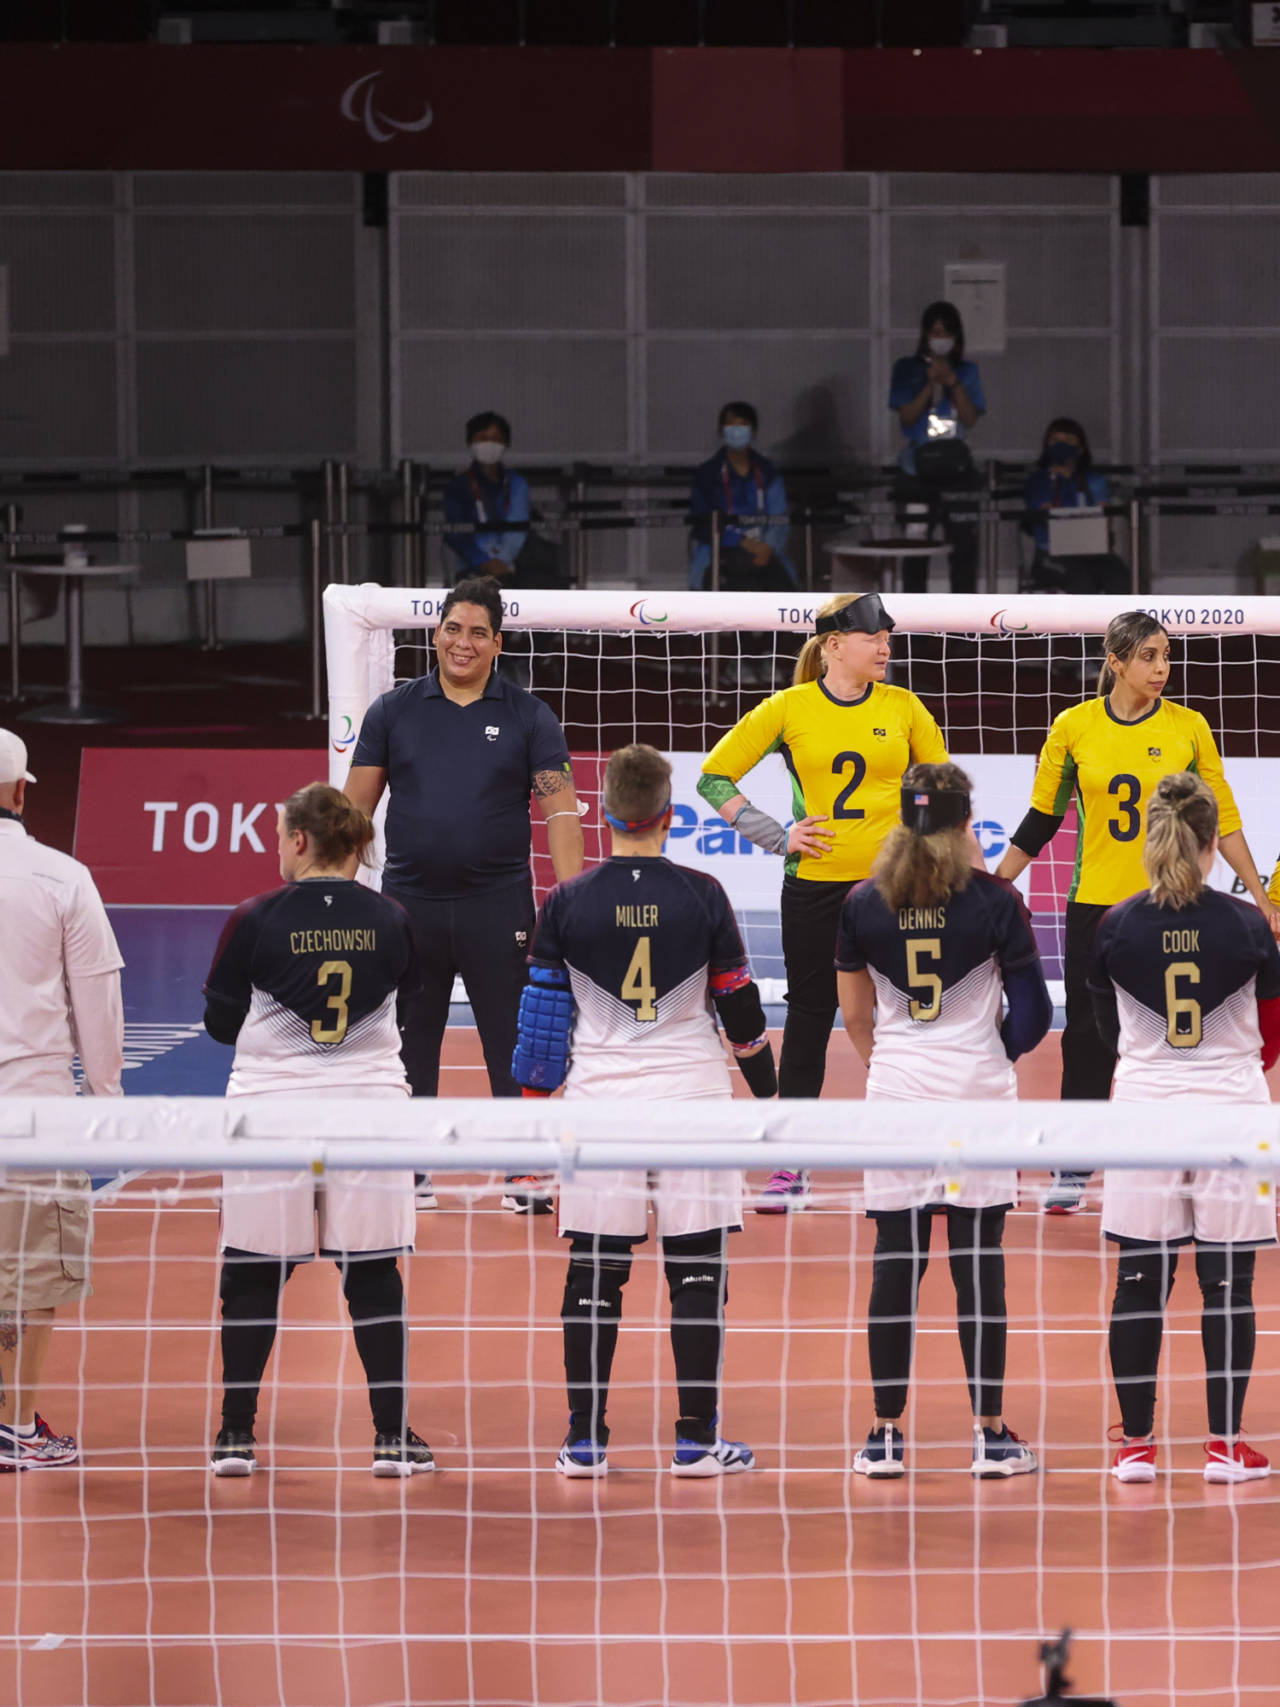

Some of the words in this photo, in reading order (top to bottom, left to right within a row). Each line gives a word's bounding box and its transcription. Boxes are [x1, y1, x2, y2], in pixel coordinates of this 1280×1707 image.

[411, 600, 445, 616] TOK
[778, 608, 819, 624] TOK
[1136, 609, 1196, 625] OKYO
[1200, 609, 1245, 625] 2020
[831, 751, 867, 820] 2
[143, 802, 283, 853] TOK
[1107, 774, 1142, 843] 3
[616, 904, 659, 927] MILLER
[899, 906, 946, 930] DENNIS
[290, 928, 376, 954] CZECHOWSKI
[1162, 930, 1201, 954] COOK
[621, 936, 658, 1022] 4
[905, 938, 943, 1022] 5
[311, 960, 353, 1044] 3
[1165, 962, 1202, 1048] 6
